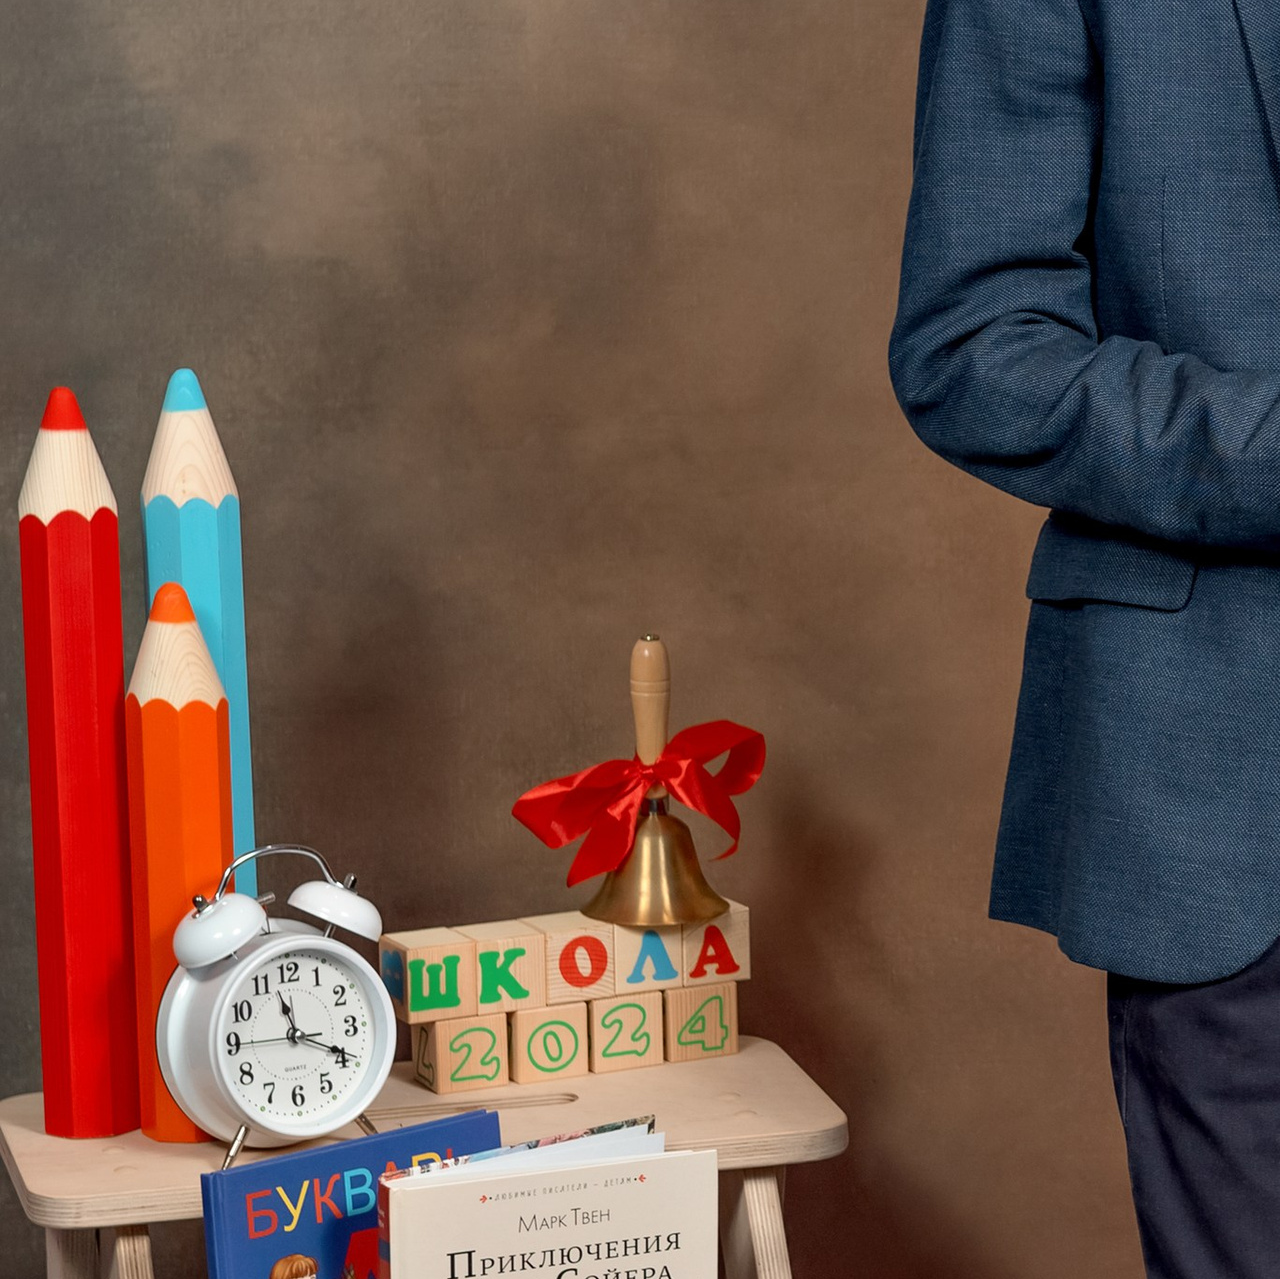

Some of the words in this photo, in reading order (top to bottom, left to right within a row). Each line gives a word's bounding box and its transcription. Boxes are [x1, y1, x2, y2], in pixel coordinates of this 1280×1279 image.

[277, 961, 300, 985] 12
[312, 966, 322, 987] 1
[408, 925, 740, 1012] ШКОЛА
[251, 973, 271, 996] 11
[332, 985, 347, 1007] 2
[232, 999, 253, 1024] 10
[343, 1015, 359, 1037] 3
[226, 1031, 241, 1056] 9
[450, 995, 728, 1081] 2024
[284, 1064, 307, 1073] QUARTZ
[334, 1046, 350, 1069] 4
[239, 1061, 254, 1085] 8
[319, 1072, 333, 1094] 5
[263, 1081, 275, 1104] 7
[291, 1085, 305, 1107] 6
[245, 1148, 453, 1240] БУКВ
[494, 1189, 537, 1201] ЛЮБИМЫЕ
[543, 1182, 588, 1195] ПИСАТЕЛИ
[604, 1176, 632, 1188] ДЕТЯМ
